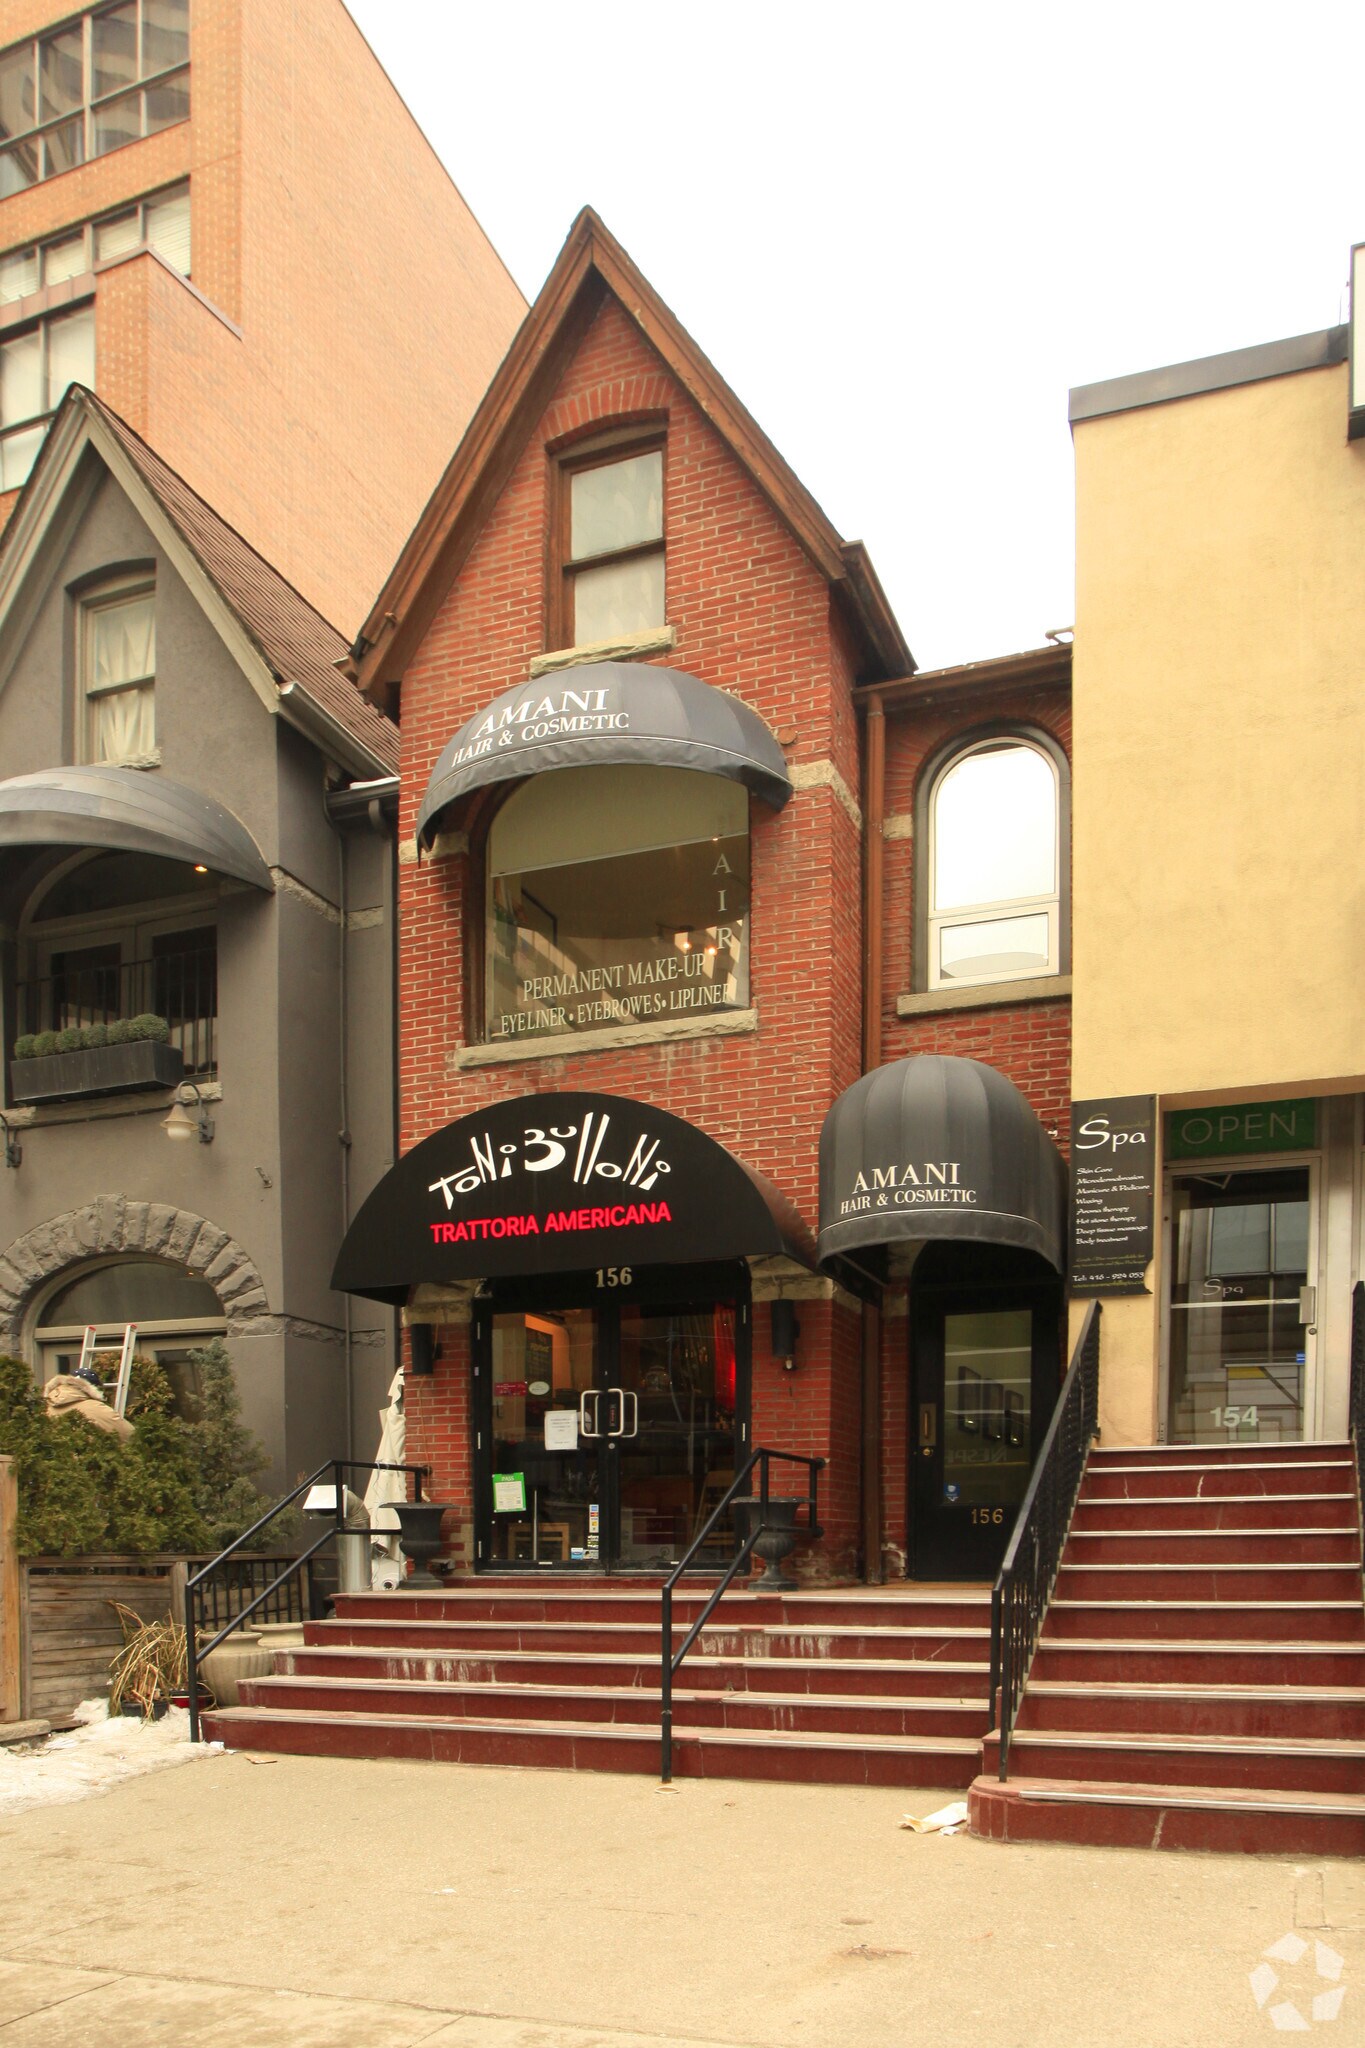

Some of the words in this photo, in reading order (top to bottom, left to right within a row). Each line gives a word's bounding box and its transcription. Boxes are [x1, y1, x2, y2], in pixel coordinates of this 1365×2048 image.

[471, 688, 610, 741] AMANI
[451, 741, 493, 768] HAIR
[498, 729, 514, 747] &
[521, 712, 630, 742] COSMETIC
[523, 965, 624, 1002] PERMANENT
[627, 953, 707, 986] MAKE-UP
[501, 1007, 566, 1034] EYELINER
[577, 992, 663, 1024] EYEBROWES
[1075, 1119, 1147, 1152] Spa
[1180, 1110, 1297, 1145] OPEN
[851, 1162, 961, 1195] AMANI
[840, 1195, 871, 1215] HAIR
[876, 1192, 889, 1207] &
[894, 1188, 977, 1204] COSMETIC
[430, 1214, 540, 1244] TRATTORIA
[544, 1201, 673, 1233] AMERICANA
[594, 1266, 633, 1289] 156
[1202, 1278, 1244, 1297] Spa
[1210, 1406, 1259, 1427] 154
[970, 1509, 1004, 1524] 156
